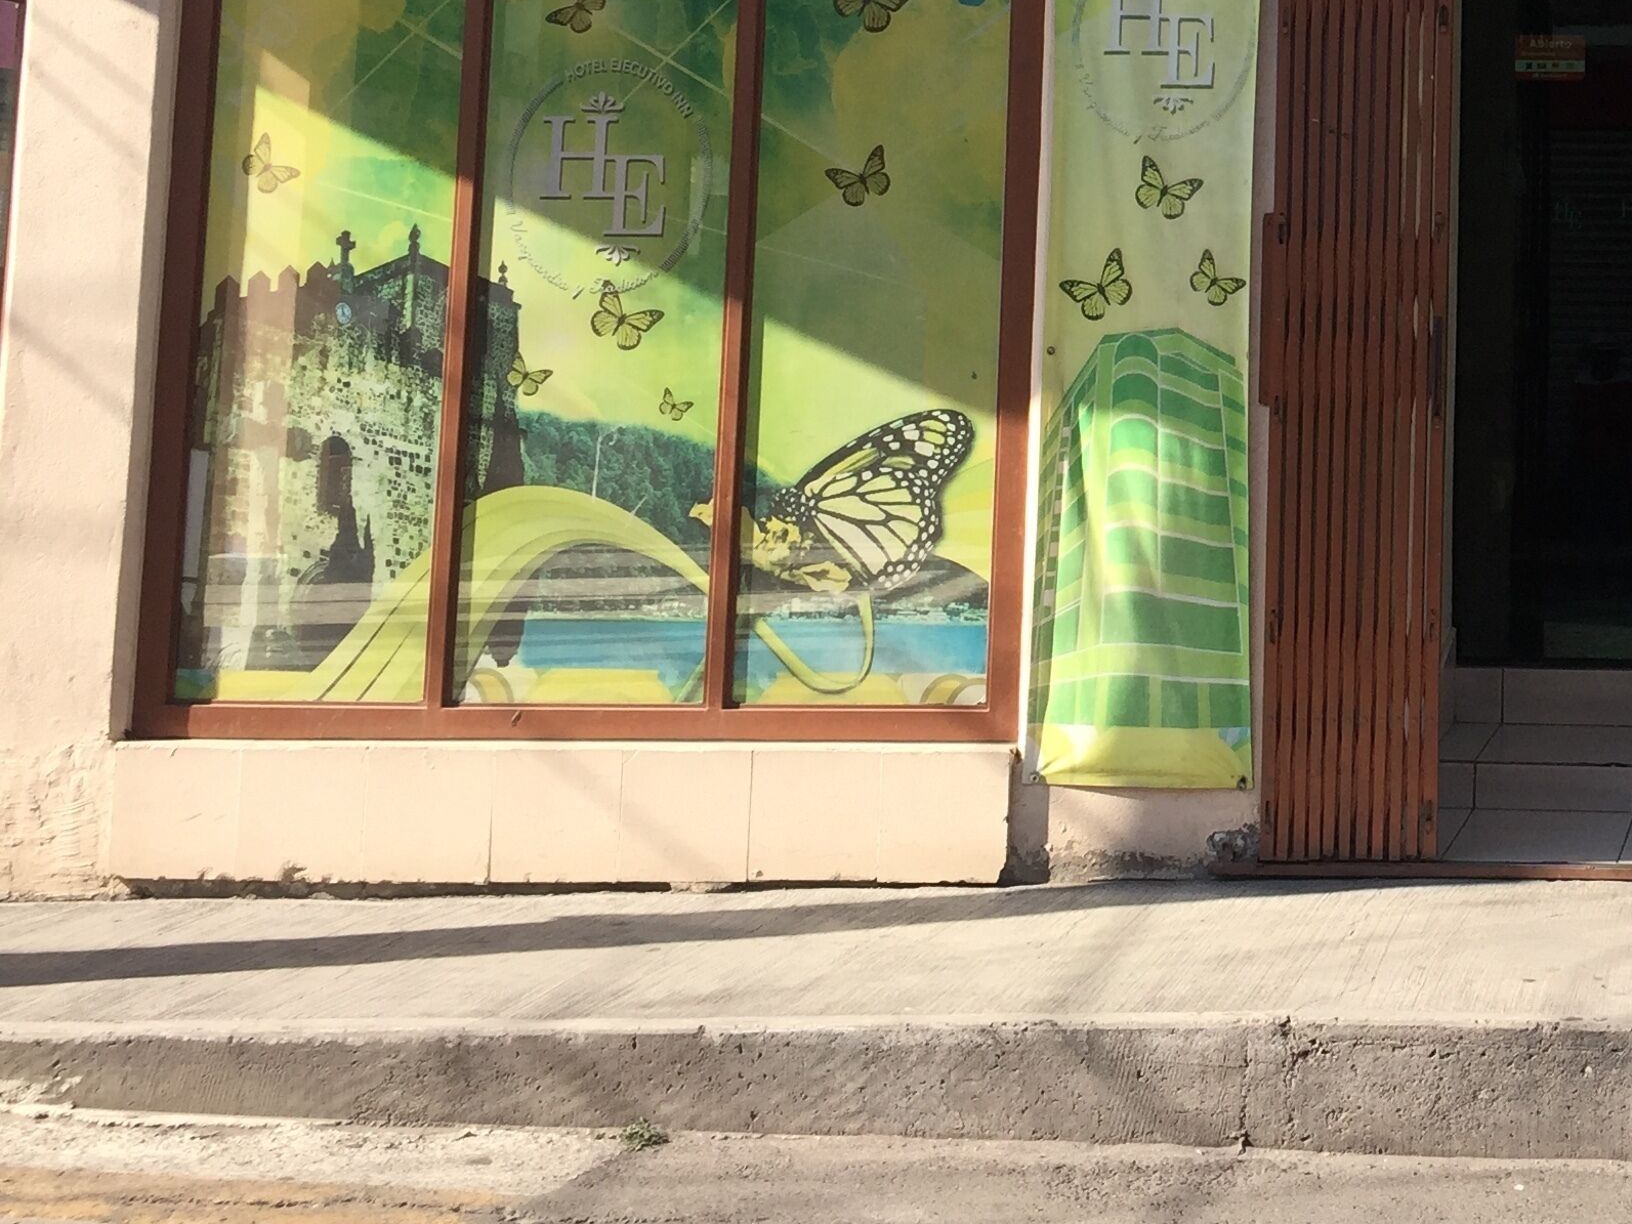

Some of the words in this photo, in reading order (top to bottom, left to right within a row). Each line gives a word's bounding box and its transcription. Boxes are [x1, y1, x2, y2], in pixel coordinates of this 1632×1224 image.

[564, 59, 608, 83] HOTEL
[610, 58, 675, 97] EJECUTIVO
[669, 91, 694, 120] INN
